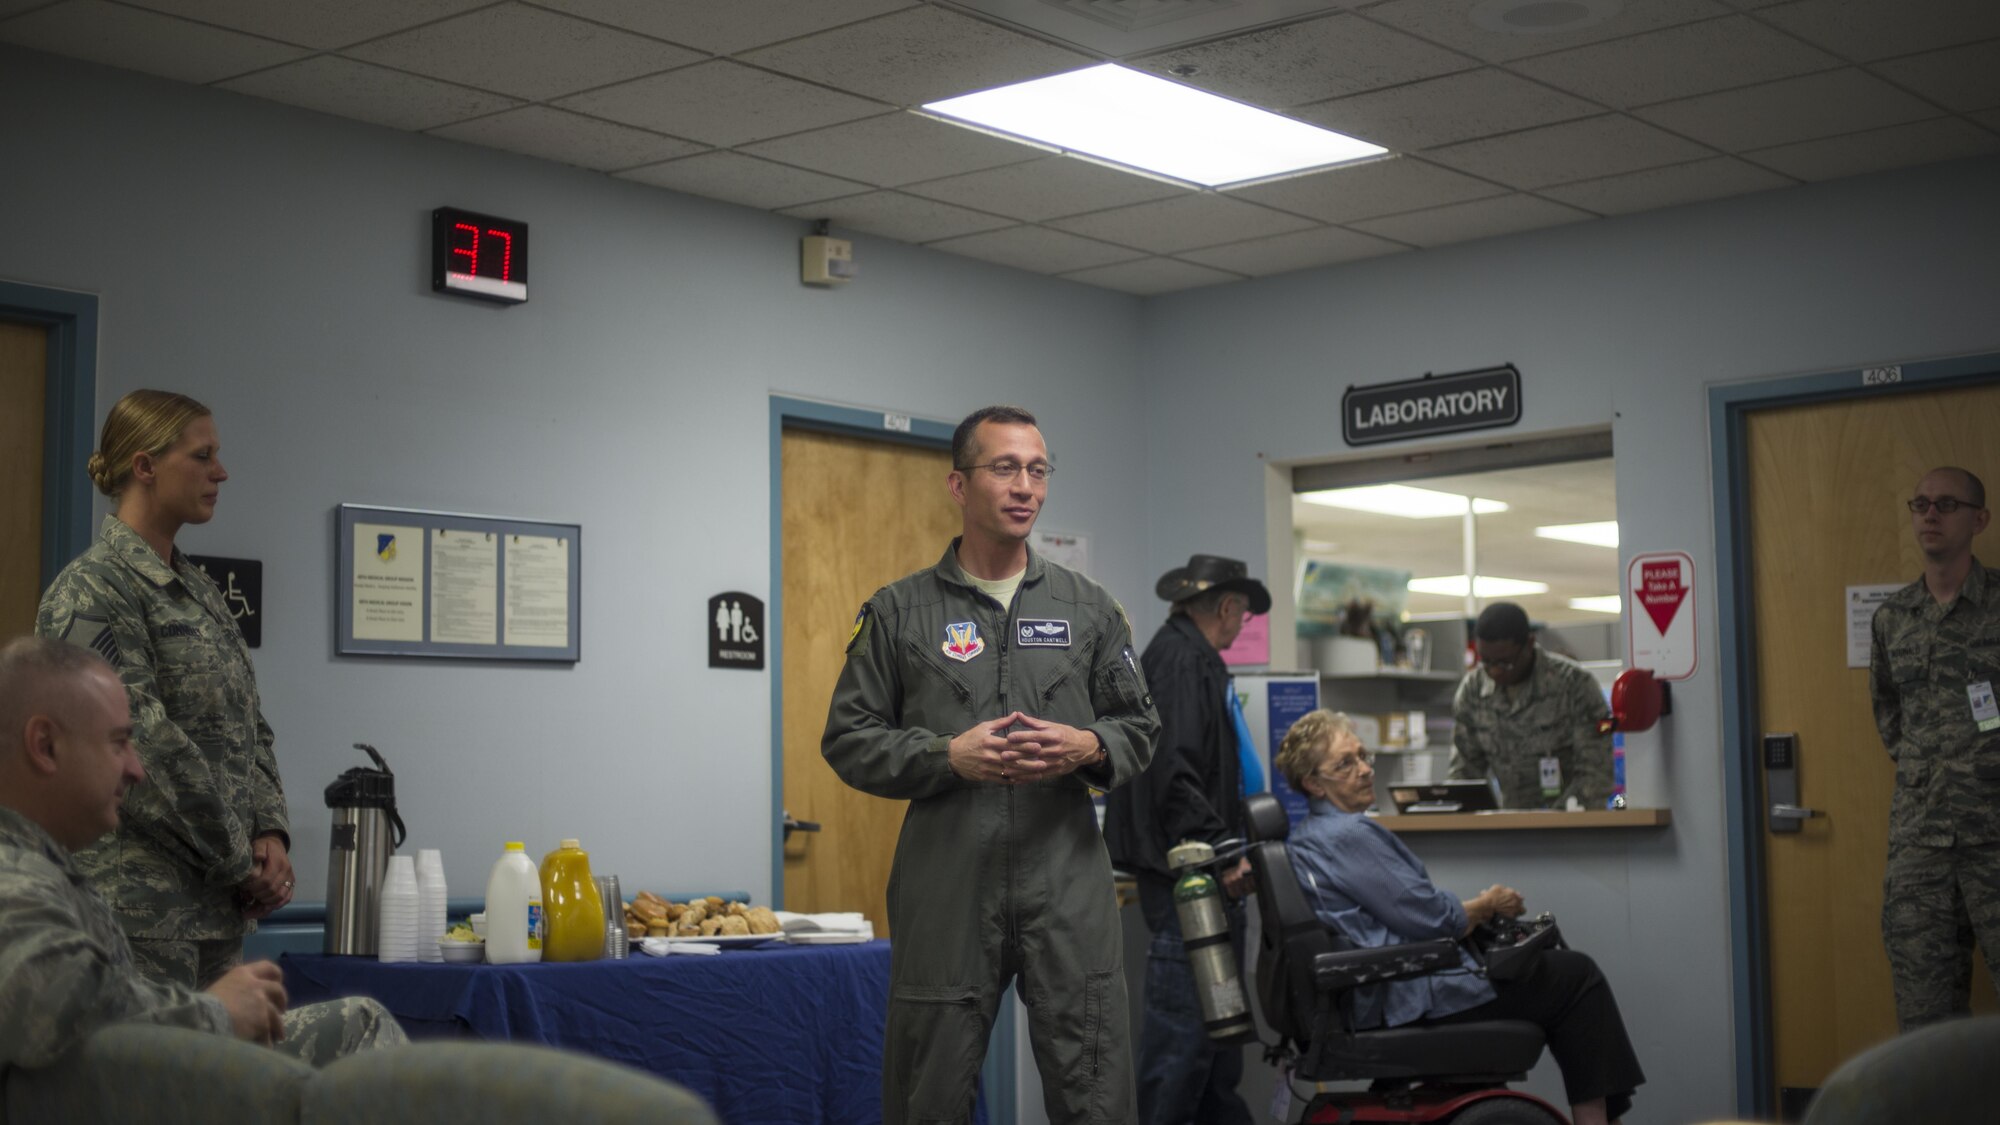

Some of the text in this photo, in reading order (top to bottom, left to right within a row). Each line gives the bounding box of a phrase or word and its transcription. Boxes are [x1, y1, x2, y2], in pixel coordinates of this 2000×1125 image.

[453, 223, 511, 285] 37
[1867, 367, 1898, 384] 406
[1355, 387, 1508, 429] LABORATORY
[1644, 568, 1678, 579] PLEASE
[1648, 580, 1677, 591] Take A
[1645, 593, 1679, 604] Number
[719, 650, 756, 660] RESTROOM
